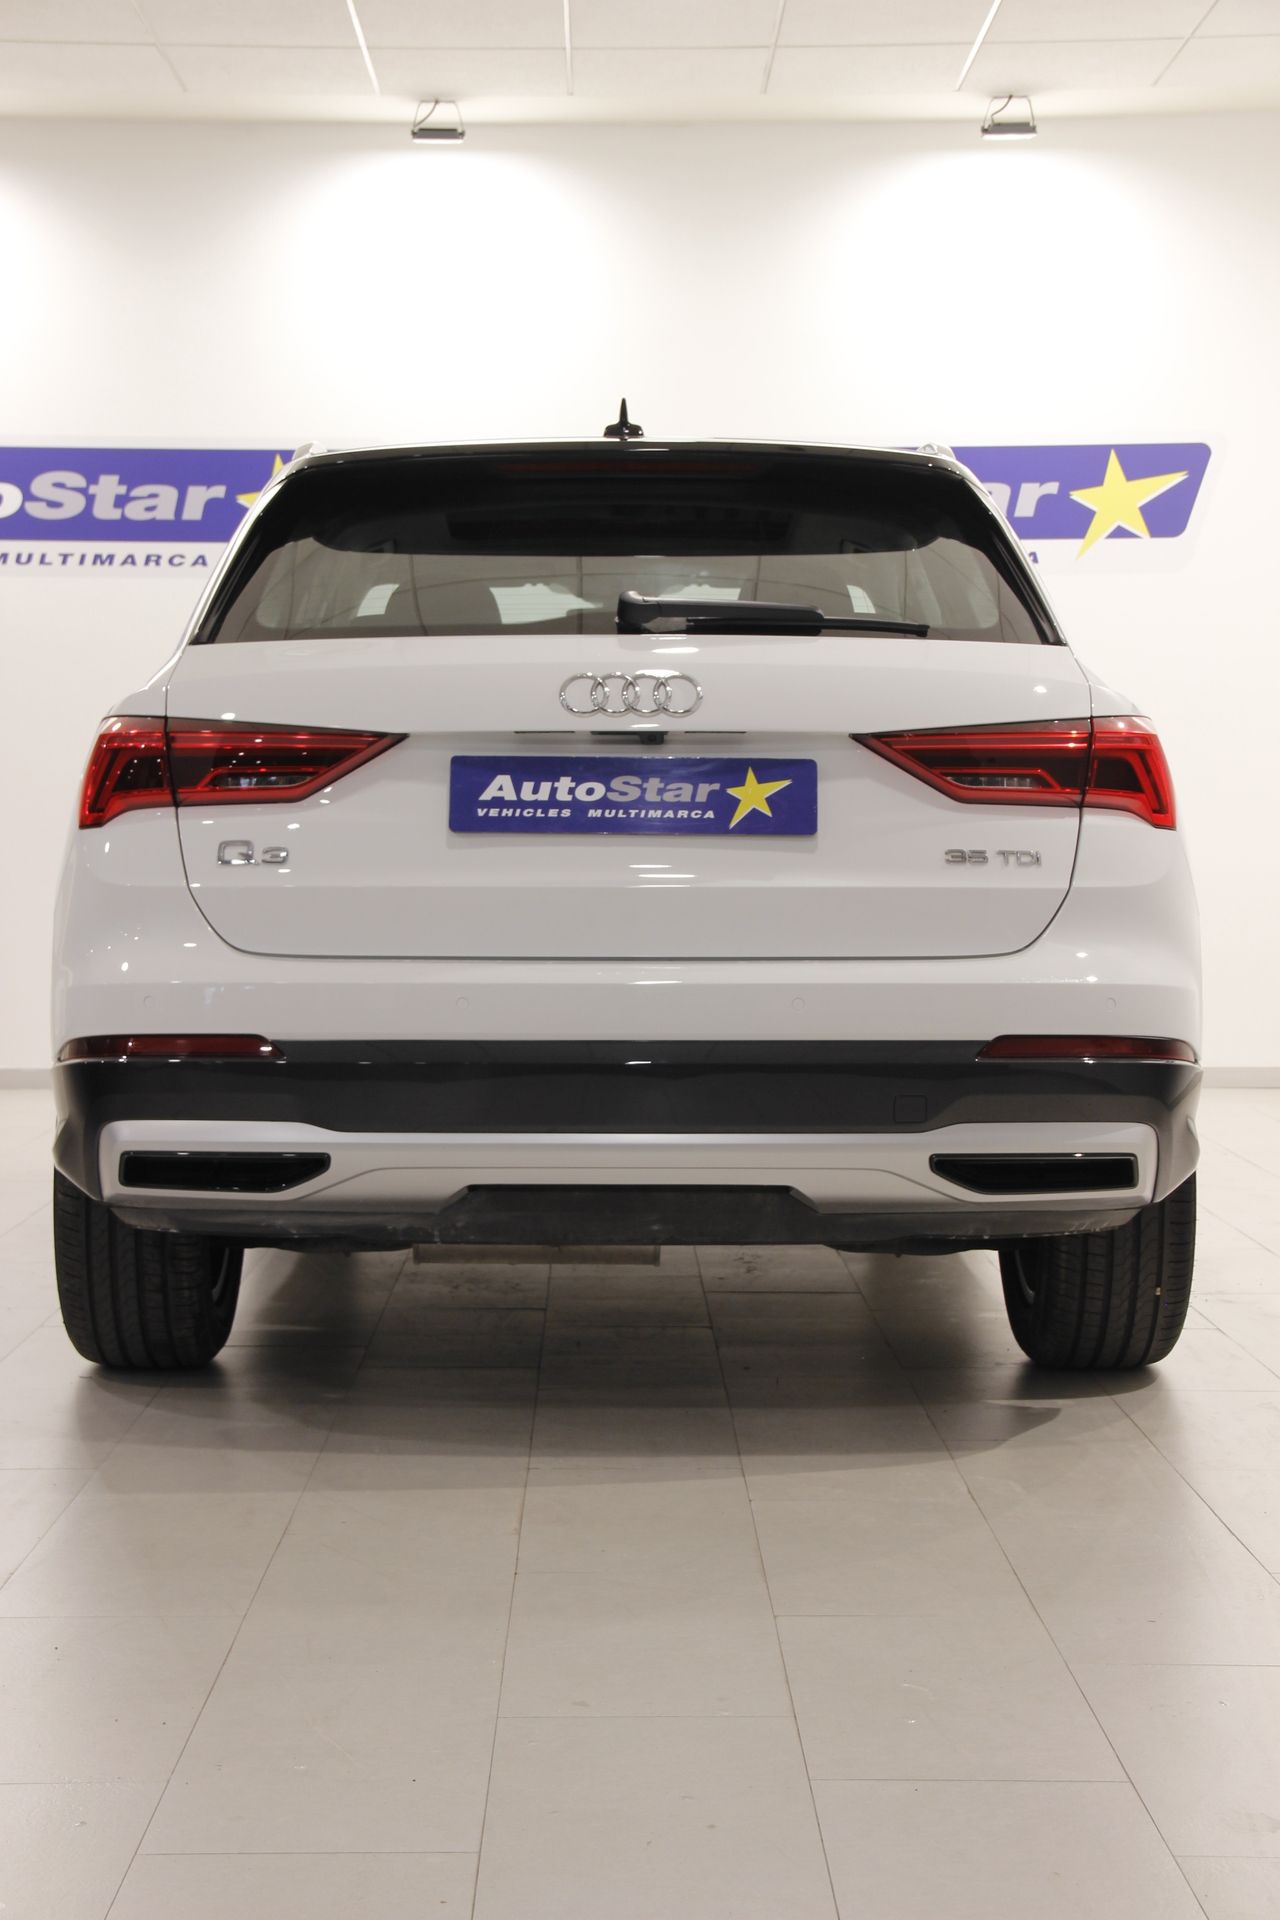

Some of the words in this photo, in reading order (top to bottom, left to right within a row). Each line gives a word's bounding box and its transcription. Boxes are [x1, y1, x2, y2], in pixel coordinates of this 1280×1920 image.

[478, 774, 721, 803] AutoStar
[476, 807, 572, 818] VEHICLES
[587, 808, 716, 819] MULTIMARCA
[217, 840, 289, 865] Q3
[944, 849, 989, 865] 35
[996, 849, 1042, 866] TDI
